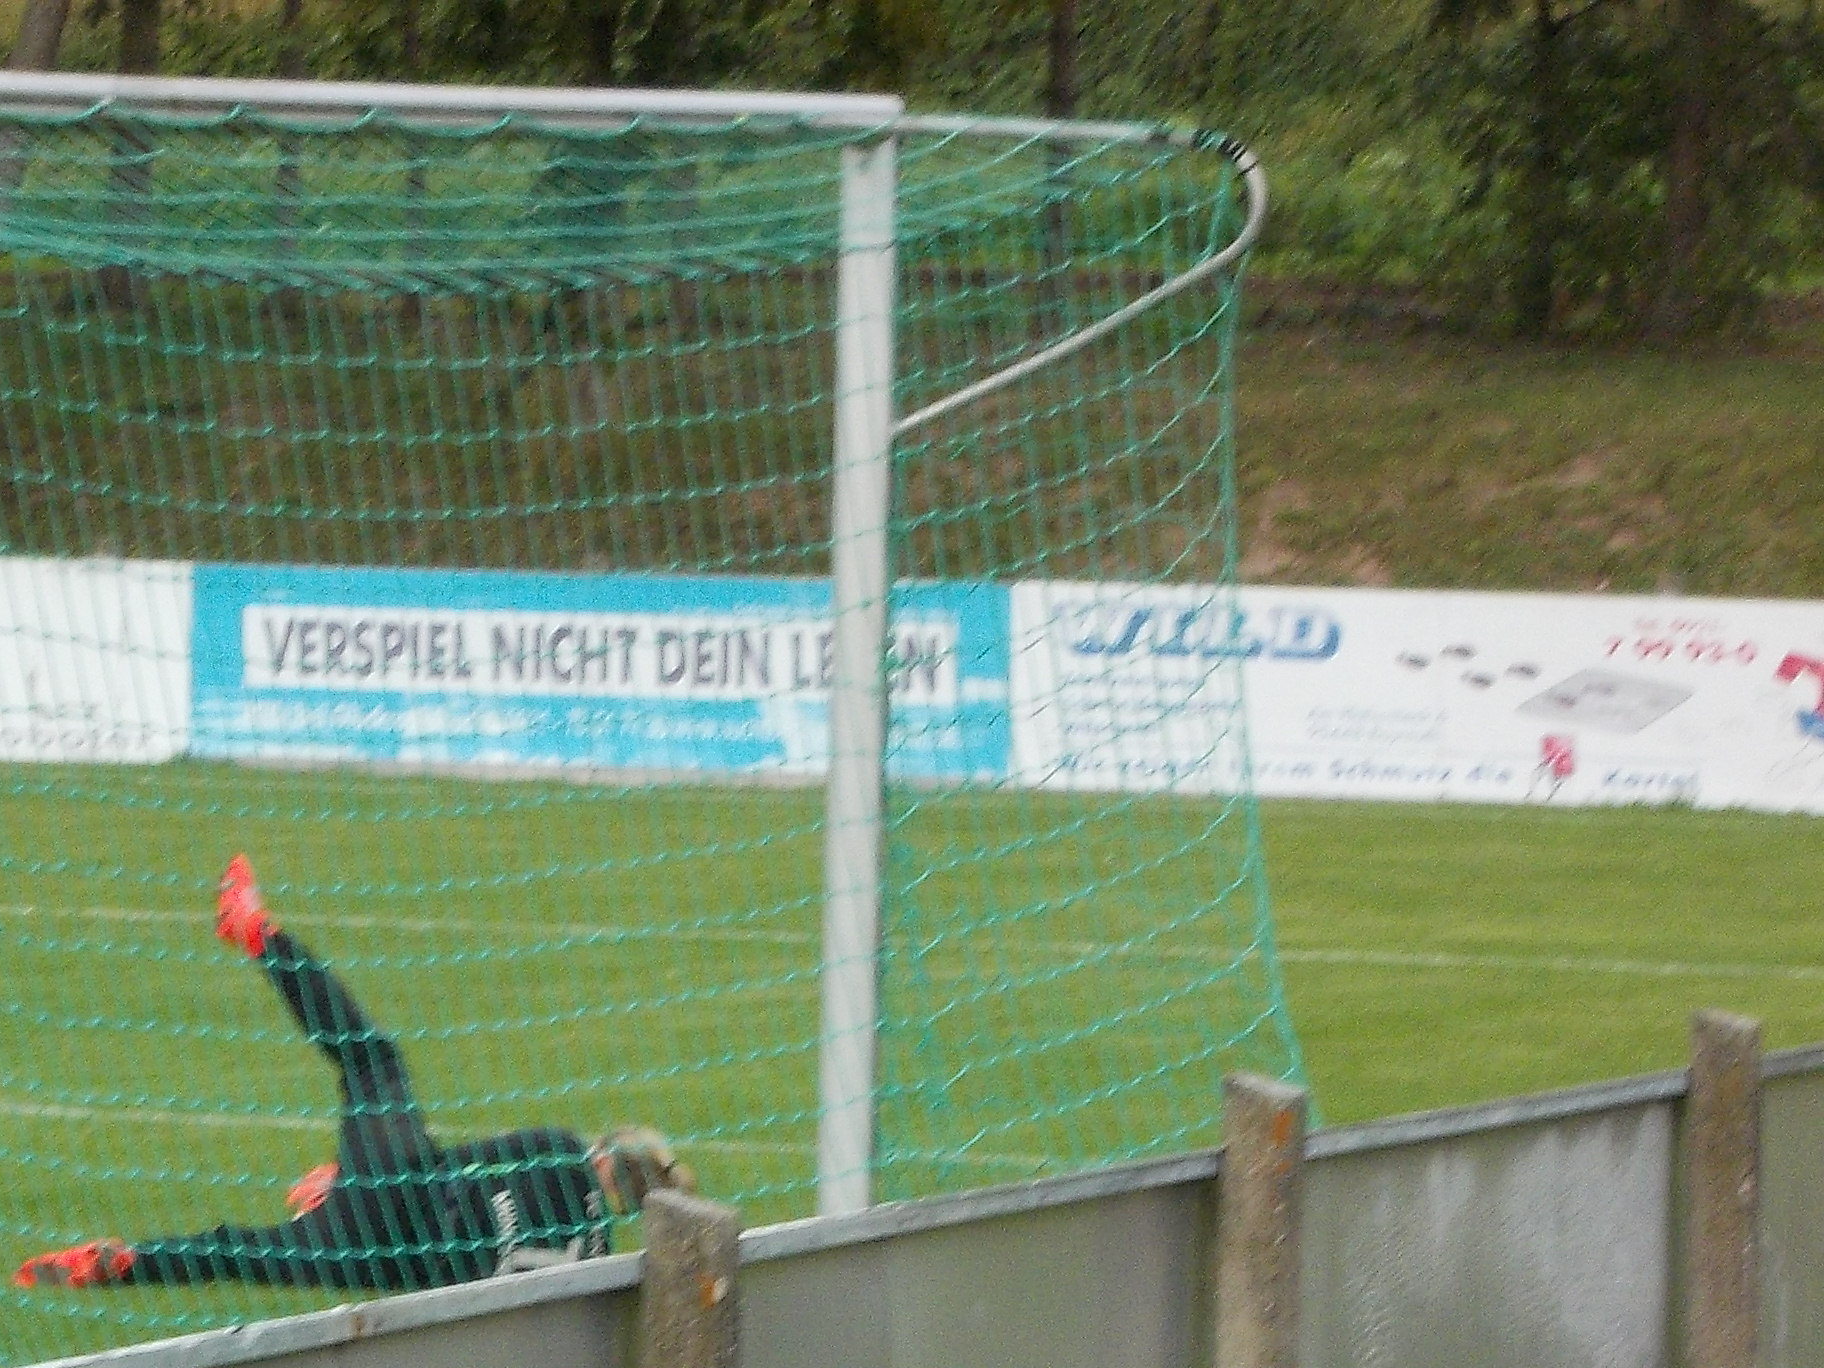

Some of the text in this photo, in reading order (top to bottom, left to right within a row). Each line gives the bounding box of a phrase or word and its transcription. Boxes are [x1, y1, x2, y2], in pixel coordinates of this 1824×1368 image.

[265, 617, 943, 695] VERSPIEL NICHT DEIN LEN
